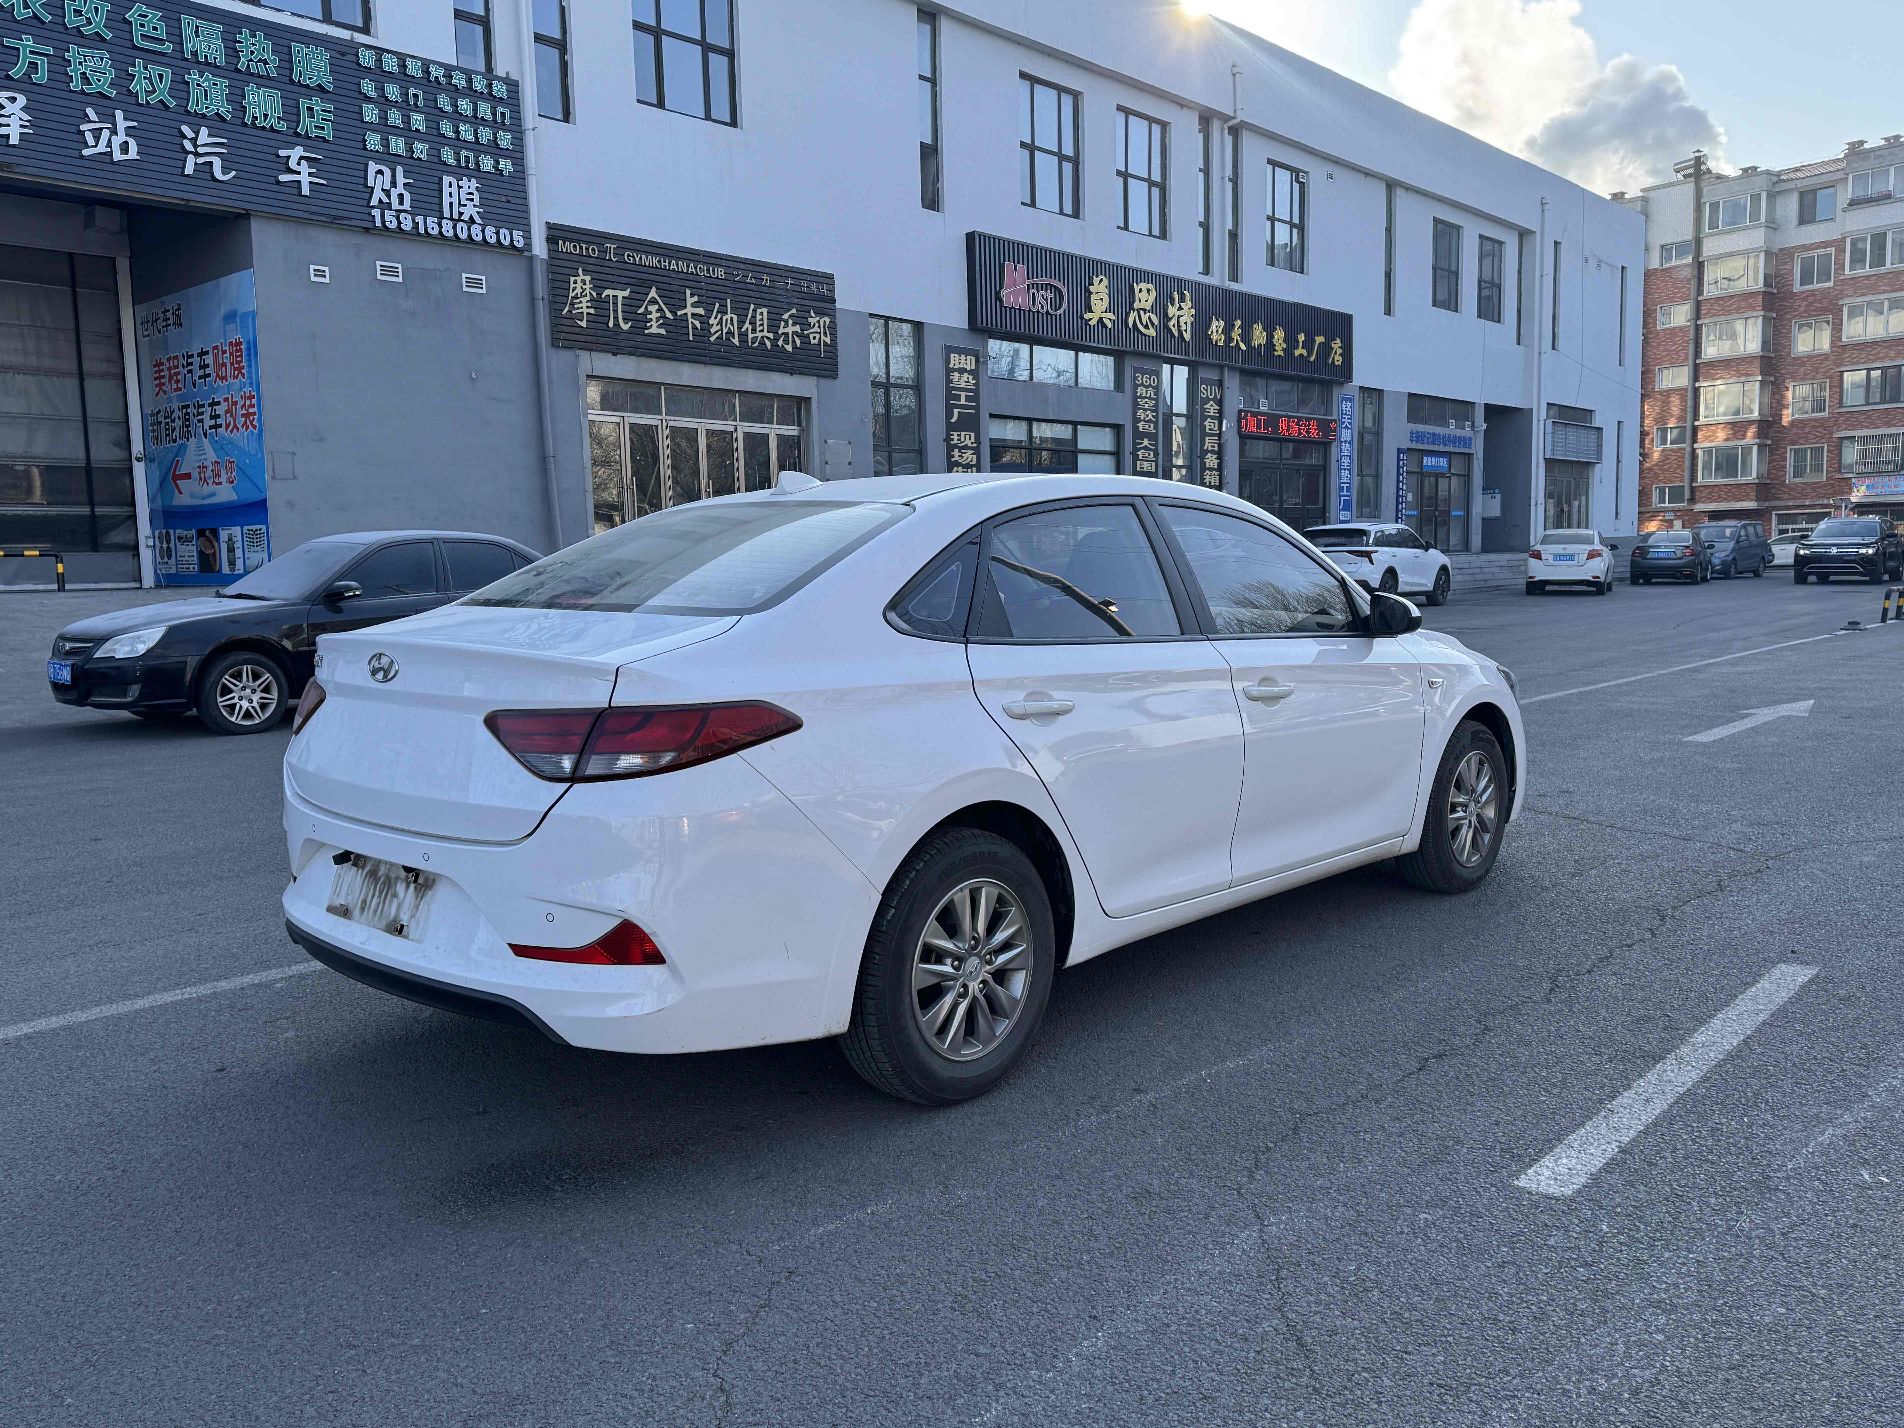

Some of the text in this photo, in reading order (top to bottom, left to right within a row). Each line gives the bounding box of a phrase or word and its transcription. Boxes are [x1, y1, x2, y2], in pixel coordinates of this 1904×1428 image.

[3, 35, 334, 141] 方授权旗舰店
[358, 48, 508, 100] 新能源汽车改装
[360, 79, 511, 125] 电吸门 电动尾门
[362, 104, 513, 150] 防虫网 电池护板
[364, 131, 514, 176] 氛围灯 电门拉手
[370, 208, 525, 248] 15915806605
[558, 239, 599, 258] MOTO
[624, 251, 726, 279] GYMKHANACLUB
[139, 302, 184, 340] 世代车城
[1083, 274, 1343, 366] 莫思特 铭天脚垫工厂店
[152, 336, 247, 399] 美程汽车贴膜
[949, 353, 976, 423] 脚垫工厂
[149, 389, 258, 448] 新能源汽车改装
[196, 458, 237, 488] 欢迎您
[1340, 400, 1353, 511] 铭天脚垫坐垫工厂
